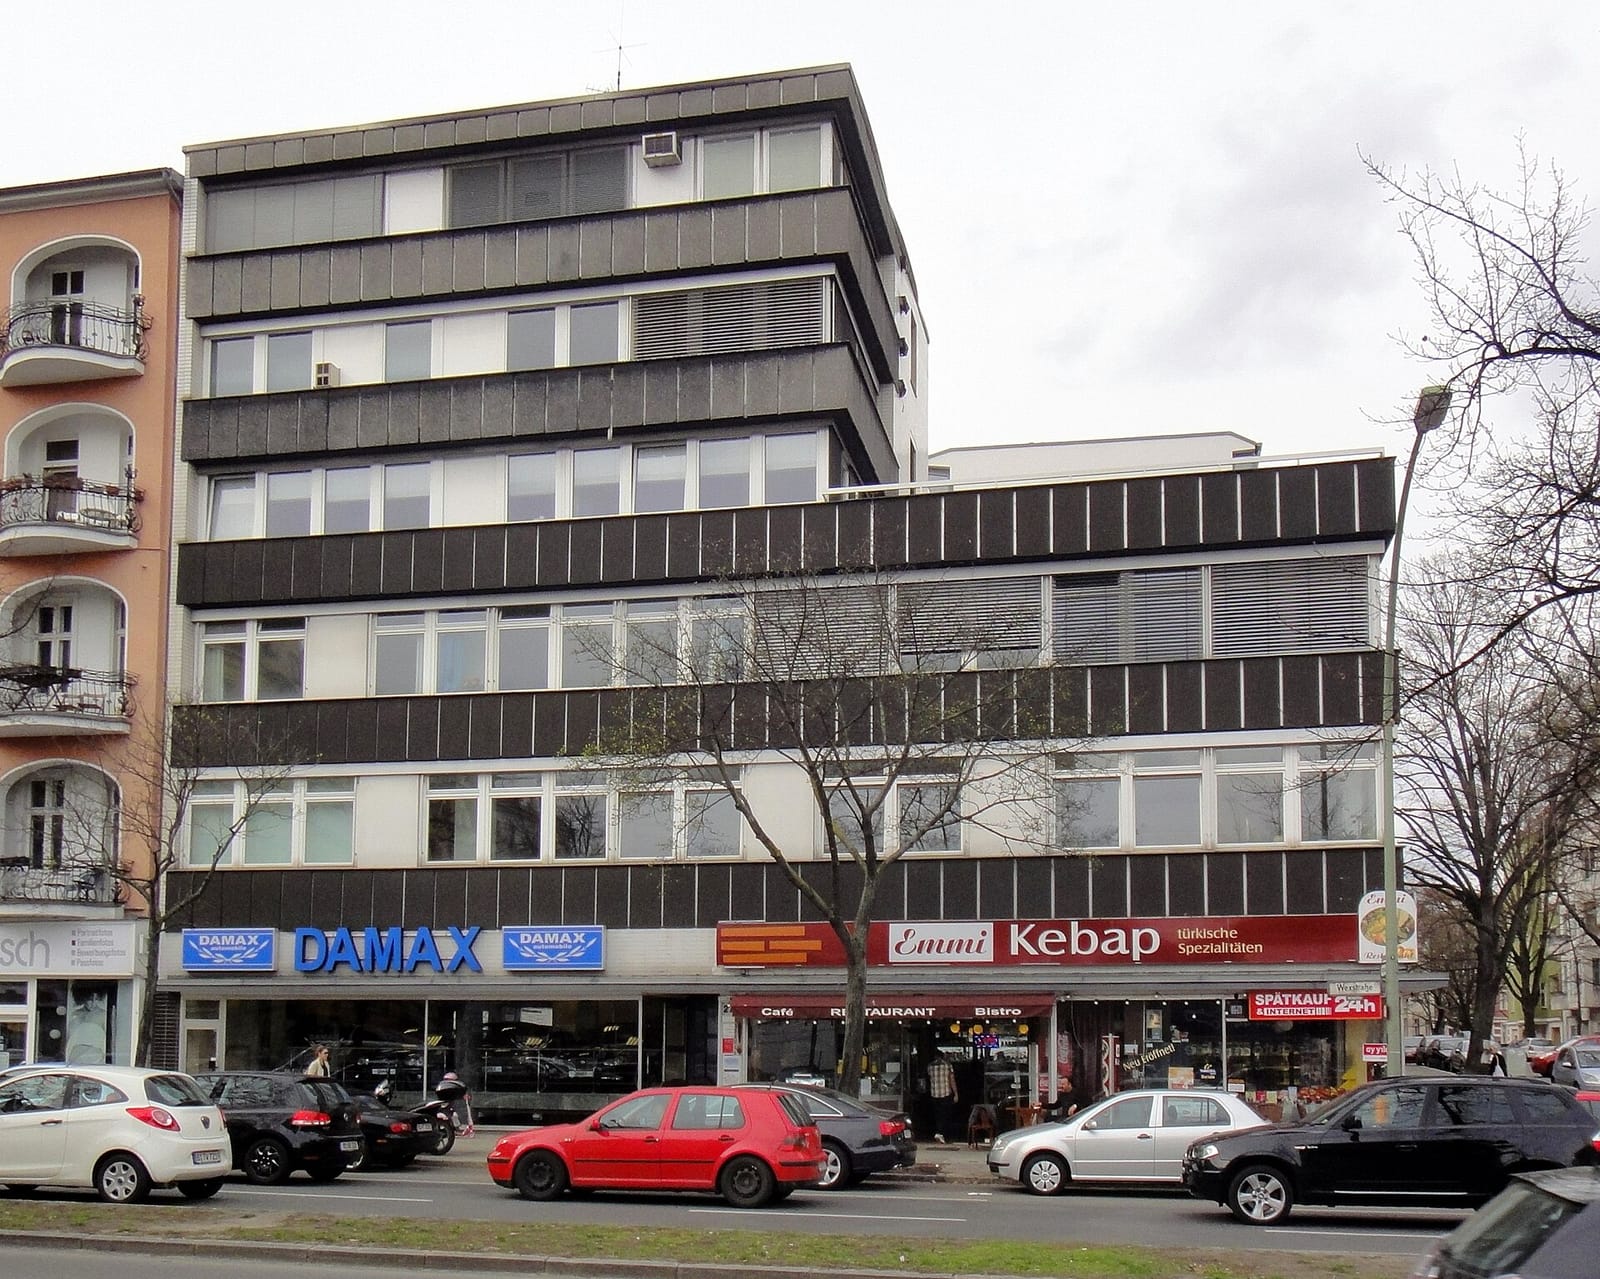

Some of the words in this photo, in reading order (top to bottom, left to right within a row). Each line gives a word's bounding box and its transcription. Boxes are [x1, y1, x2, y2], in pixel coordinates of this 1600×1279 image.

[519, 932, 586, 944] DAMAX
[1177, 928, 1238, 939] türkische
[199, 935, 259, 946] DAMAX
[894, 928, 987, 954] Emmi
[1010, 921, 1160, 961] Kebap
[294, 926, 483, 973] DAMAX
[1178, 942, 1263, 955] Spezialitäten
[1334, 996, 1376, 1013] 24h
[761, 1007, 794, 1017] Café
[830, 1008, 936, 1017] RTAURANT
[975, 1007, 1022, 1016] Bistro
[1122, 1059, 1142, 1072] Neu
